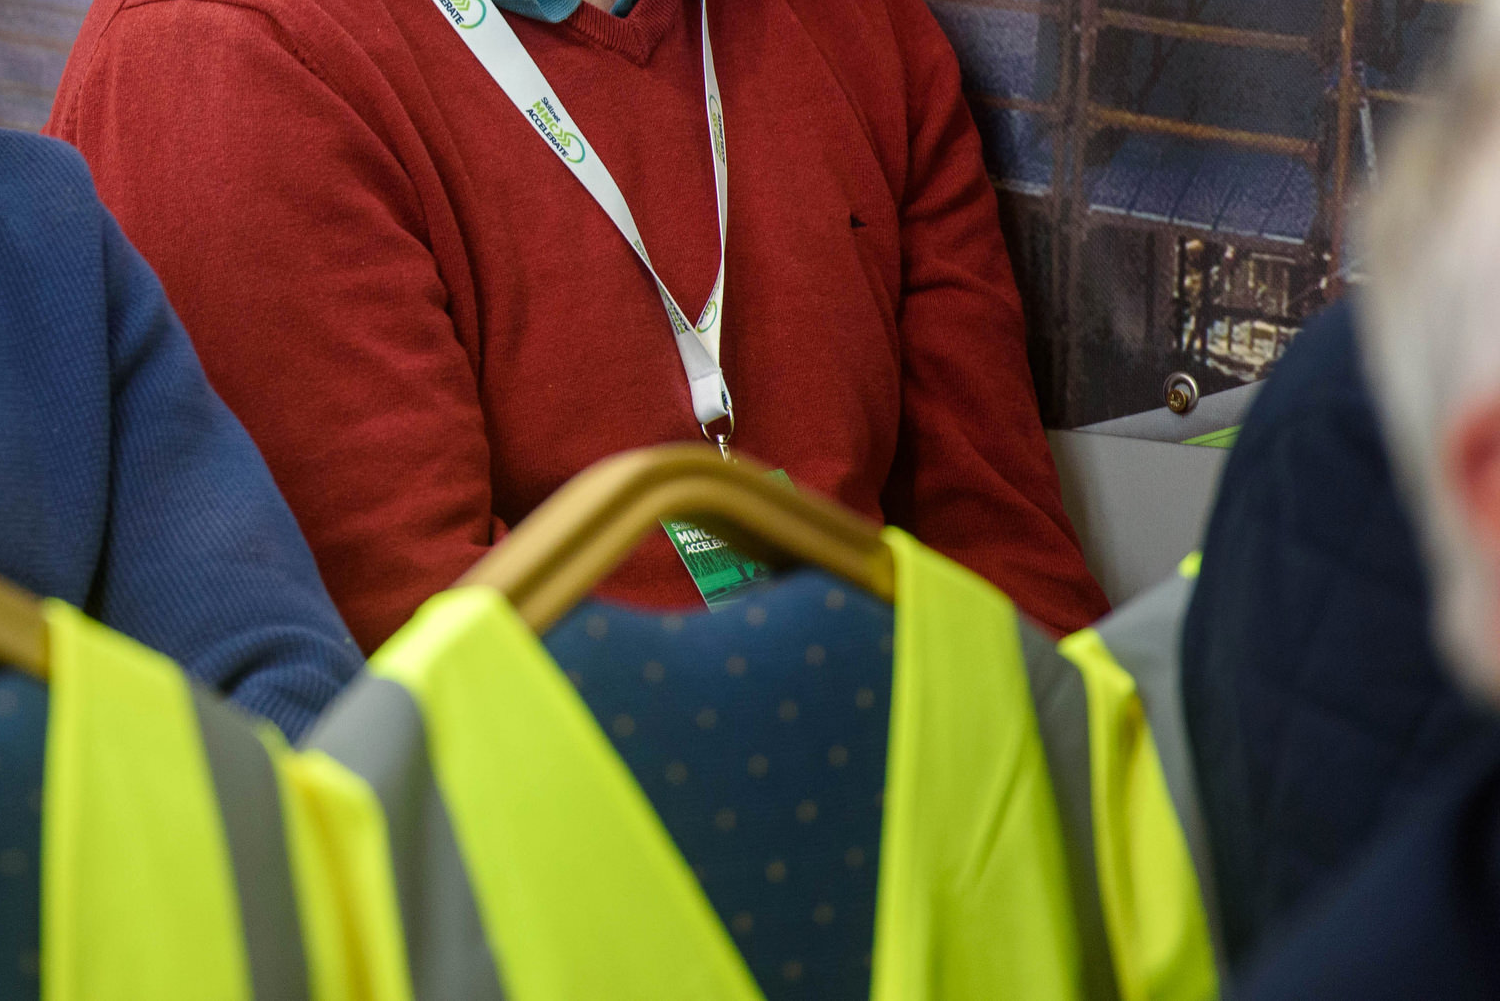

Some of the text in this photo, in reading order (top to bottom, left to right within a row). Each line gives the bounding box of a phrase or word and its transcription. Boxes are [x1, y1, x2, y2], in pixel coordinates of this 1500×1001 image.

[532, 100, 559, 132] MMC
[540, 96, 561, 123] Skillnet
[525, 108, 569, 158] ACCELERATE
